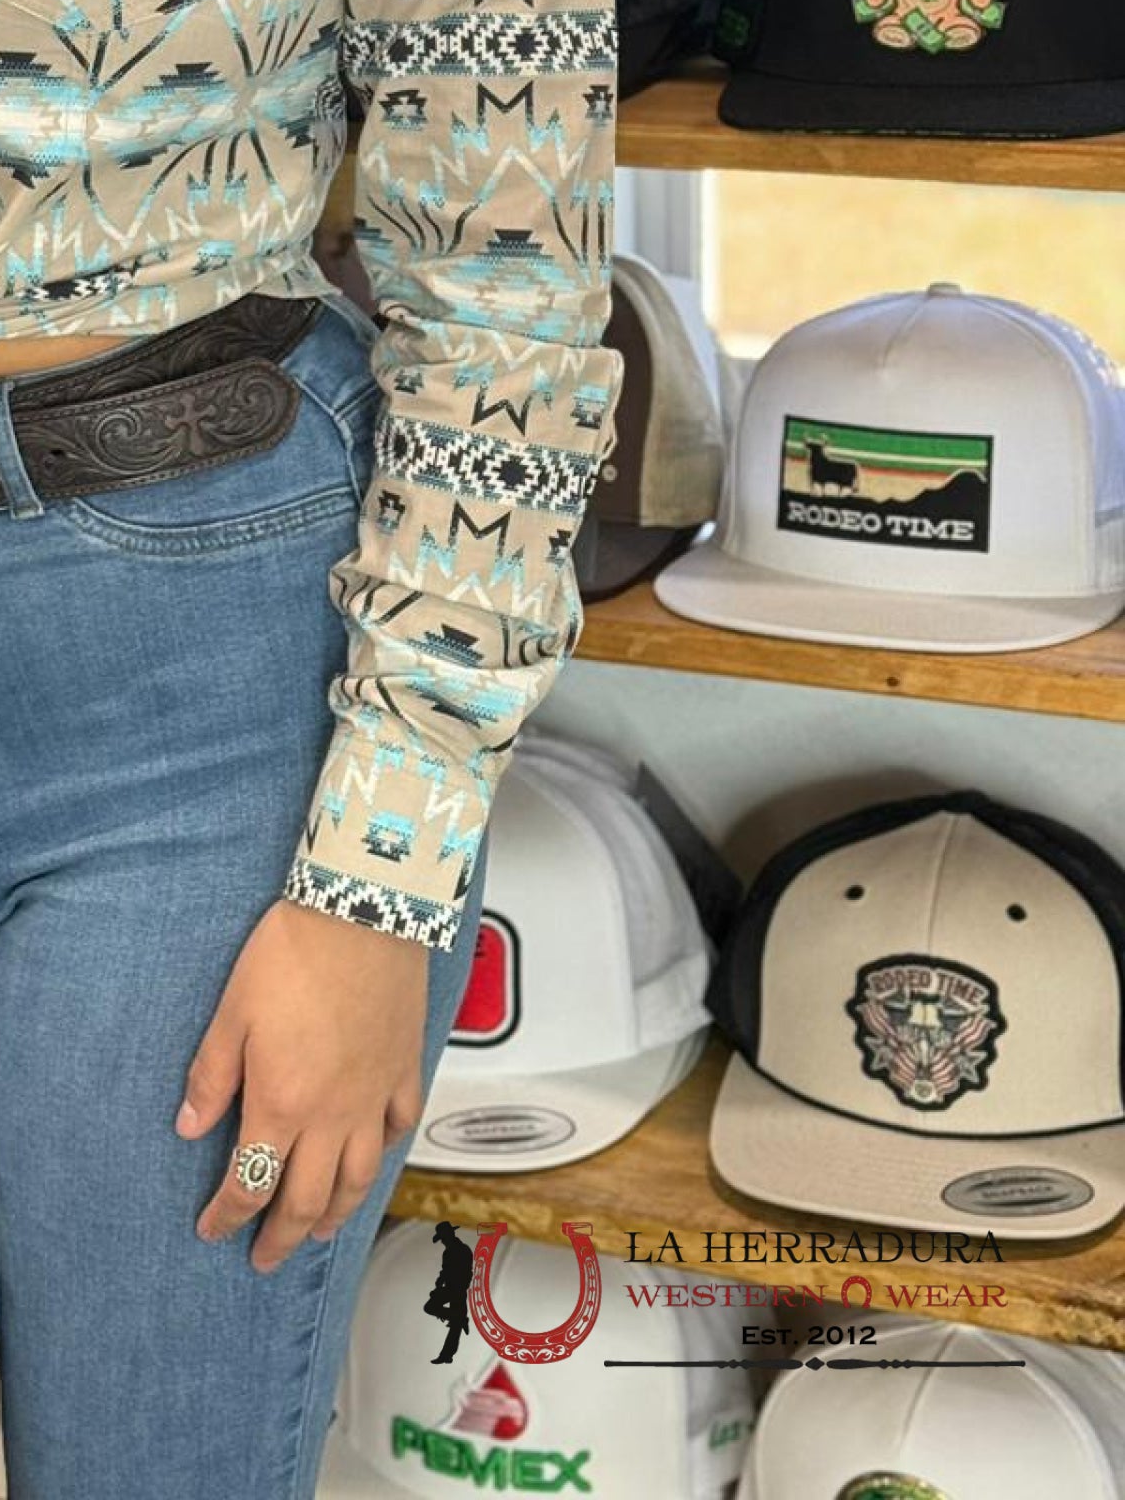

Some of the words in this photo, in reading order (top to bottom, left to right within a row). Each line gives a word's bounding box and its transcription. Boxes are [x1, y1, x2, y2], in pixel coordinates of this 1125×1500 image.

[787, 501, 882, 534] RODEO
[885, 514, 975, 541] TIME
[871, 970, 931, 993] RODEO
[937, 972, 983, 1002] TIME
[391, 1414, 592, 1494] PEMEX
